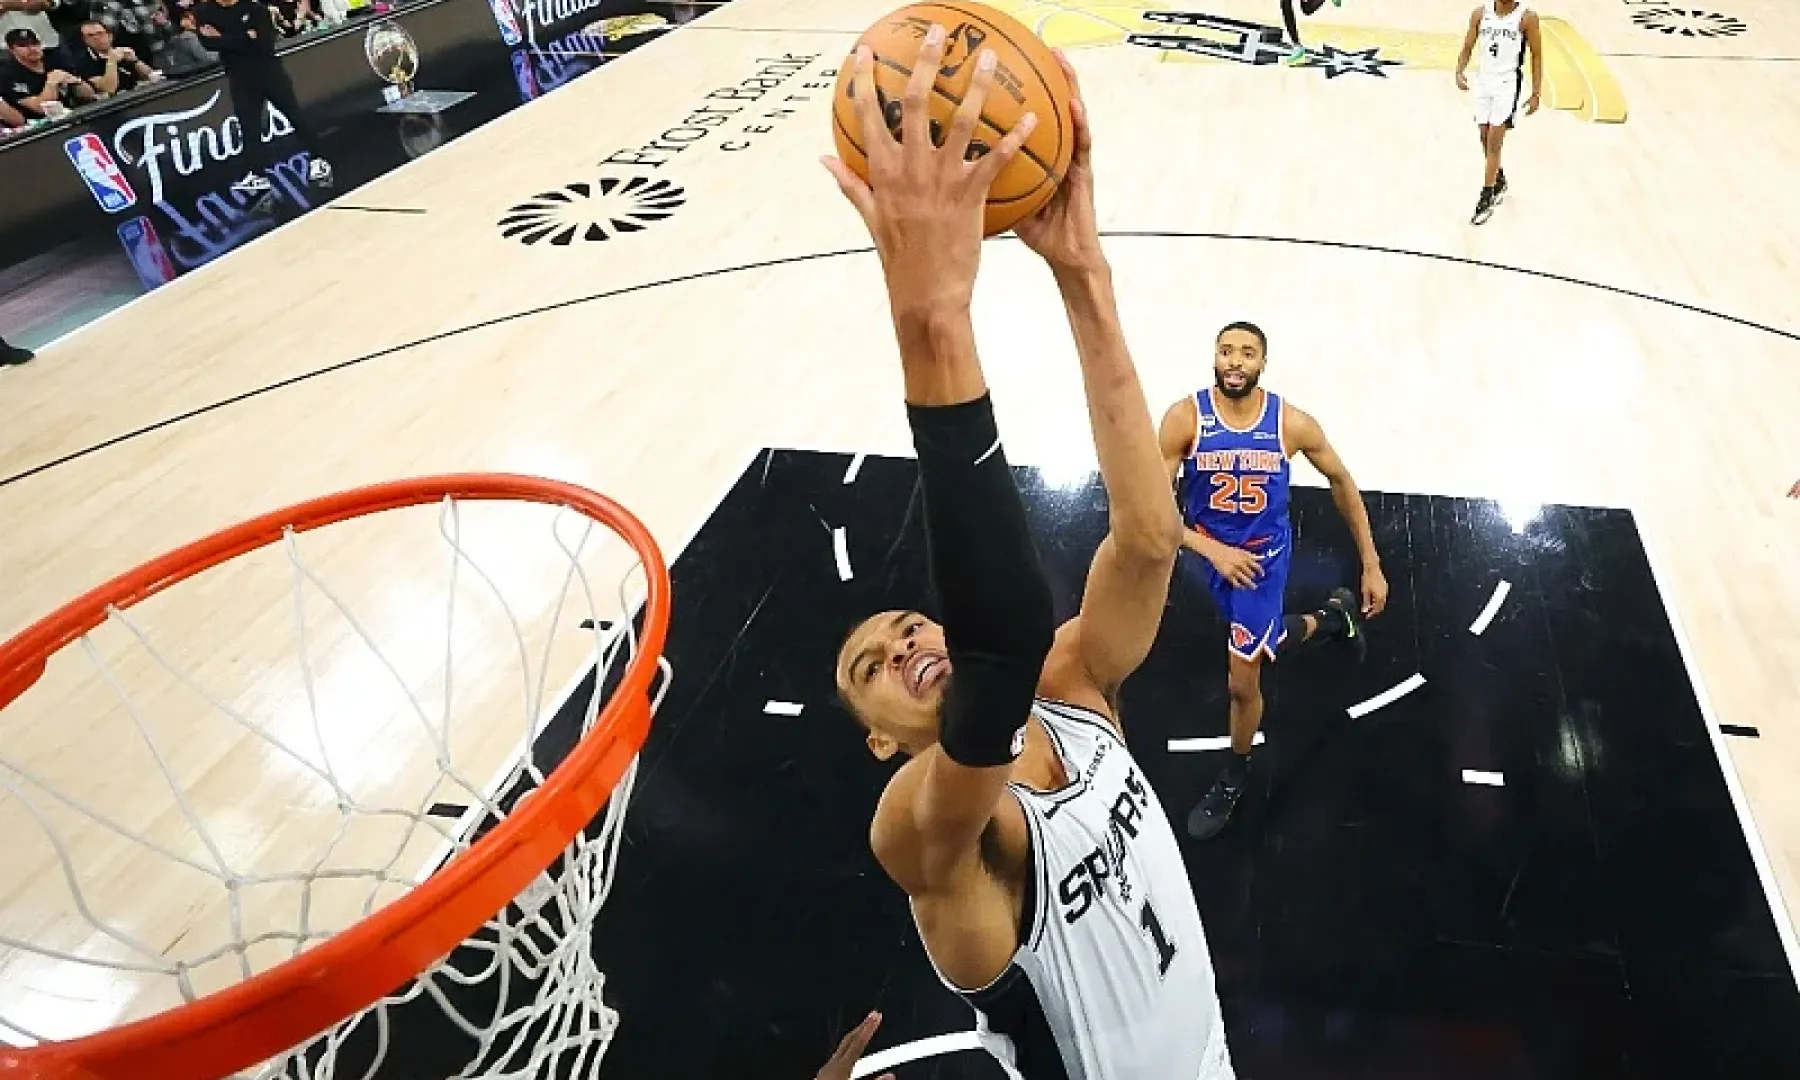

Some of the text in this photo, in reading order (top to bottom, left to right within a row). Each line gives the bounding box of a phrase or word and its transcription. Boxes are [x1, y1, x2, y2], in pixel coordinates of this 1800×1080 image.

[1489, 42, 1499, 57] 4
[597, 53, 822, 168] Frost Bank
[1197, 450, 1281, 472] NEW YORK
[1210, 472, 1269, 513] 25
[1141, 896, 1178, 978] 1
